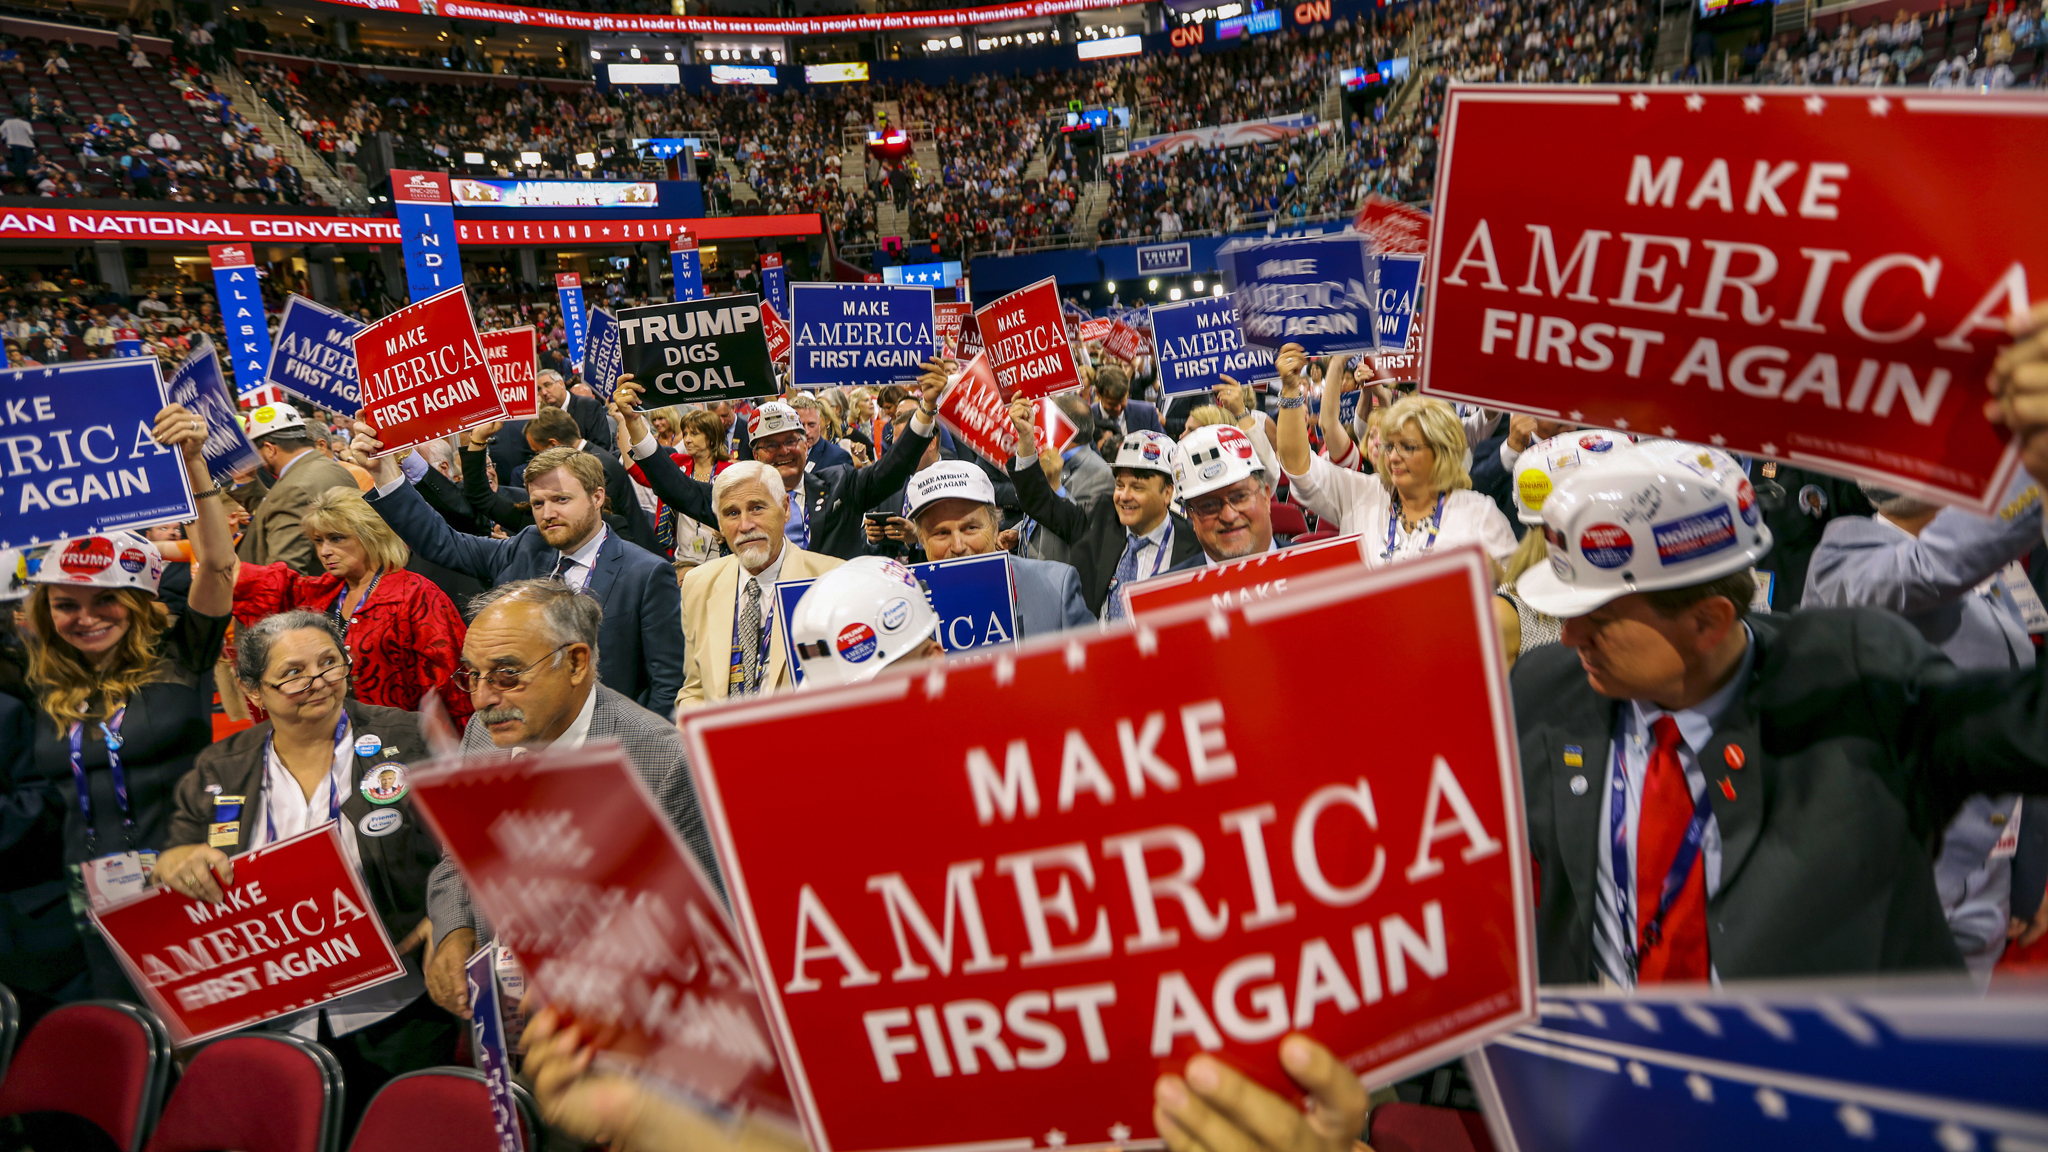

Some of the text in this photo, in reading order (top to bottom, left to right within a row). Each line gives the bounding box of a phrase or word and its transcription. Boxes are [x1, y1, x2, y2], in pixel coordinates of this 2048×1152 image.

[445, 4, 528, 24] @annanaugh
[566, 15, 591, 28] true
[592, 15, 613, 31] gift
[615, 20, 629, 29] as
[630, 20, 638, 29] a
[639, 18, 676, 30] leader
[677, 19, 687, 31] is
[688, 19, 711, 31] that
[713, 20, 728, 31] he
[729, 22, 751, 32] sees
[753, 20, 809, 34] something
[810, 20, 821, 31] in
[822, 18, 858, 33] people
[858, 16, 881, 30] they
[883, 15, 912, 27] don't
[913, 16, 943, 26] even
[945, 15, 956, 24] see
[956, 12, 967, 23] in
[1294, 0, 1331, 25] CNN
[1171, 25, 1204, 48] CNN
[1625, 155, 1850, 220] MAKE
[68, 215, 244, 236] NATIONAL
[460, 223, 591, 240] CLEVELAND
[681, 253, 692, 279] NEW
[1144, 249, 1184, 260] TRUMP
[1442, 218, 2034, 353] AMERICA
[229, 271, 263, 370] ALASKA
[566, 290, 585, 353] NEBRASKA
[843, 301, 890, 317] MAKE
[997, 308, 1027, 333] MAKE
[1196, 308, 1240, 329] MAKE
[619, 305, 760, 346] TRUMP
[796, 322, 933, 347] AMERICA
[1285, 313, 1358, 337] AGAIN
[385, 325, 428, 357] MAKE
[589, 335, 599, 365] MAKE
[663, 342, 720, 367] DIGS
[987, 320, 1067, 369] AMERICA
[363, 338, 483, 406] AMERICA
[594, 320, 618, 396] AMERICA
[809, 350, 922, 368] FIRST AGAIN
[997, 366, 1018, 389] FIRST
[1020, 353, 1063, 382] AGAIN
[1174, 350, 1276, 380] FIRST AGAIN
[1374, 354, 1414, 370] FIRST
[1481, 307, 1952, 426] FIRST AGAIN
[285, 357, 333, 391] FIRST
[604, 364, 617, 396] FIRST
[655, 365, 746, 395] COAL
[373, 396, 418, 430] FIRST
[422, 376, 481, 415] AGAIN
[1222, 438, 1251, 449] TRUMP
[19, 466, 151, 515] AGAIN
[917, 472, 970, 490] MAKE AMERICA
[921, 480, 967, 496] GREAT AGAIN
[60, 553, 112, 564] TRUMP
[884, 600, 906, 618] Friends
[838, 624, 868, 643] TRUMP
[848, 634, 863, 646] 2016
[845, 641, 876, 660] AMERICA
[965, 699, 1237, 826] MAKE
[371, 813, 397, 822] Friends
[785, 754, 1502, 995] AMERICA
[183, 880, 268, 925] MAKE
[139, 887, 367, 987] AMERICA
[173, 966, 262, 1012] FIRST
[265, 933, 361, 986] AGAIN
[861, 983, 1117, 1083] FIRST
[1150, 899, 1449, 1059] AGAIN
